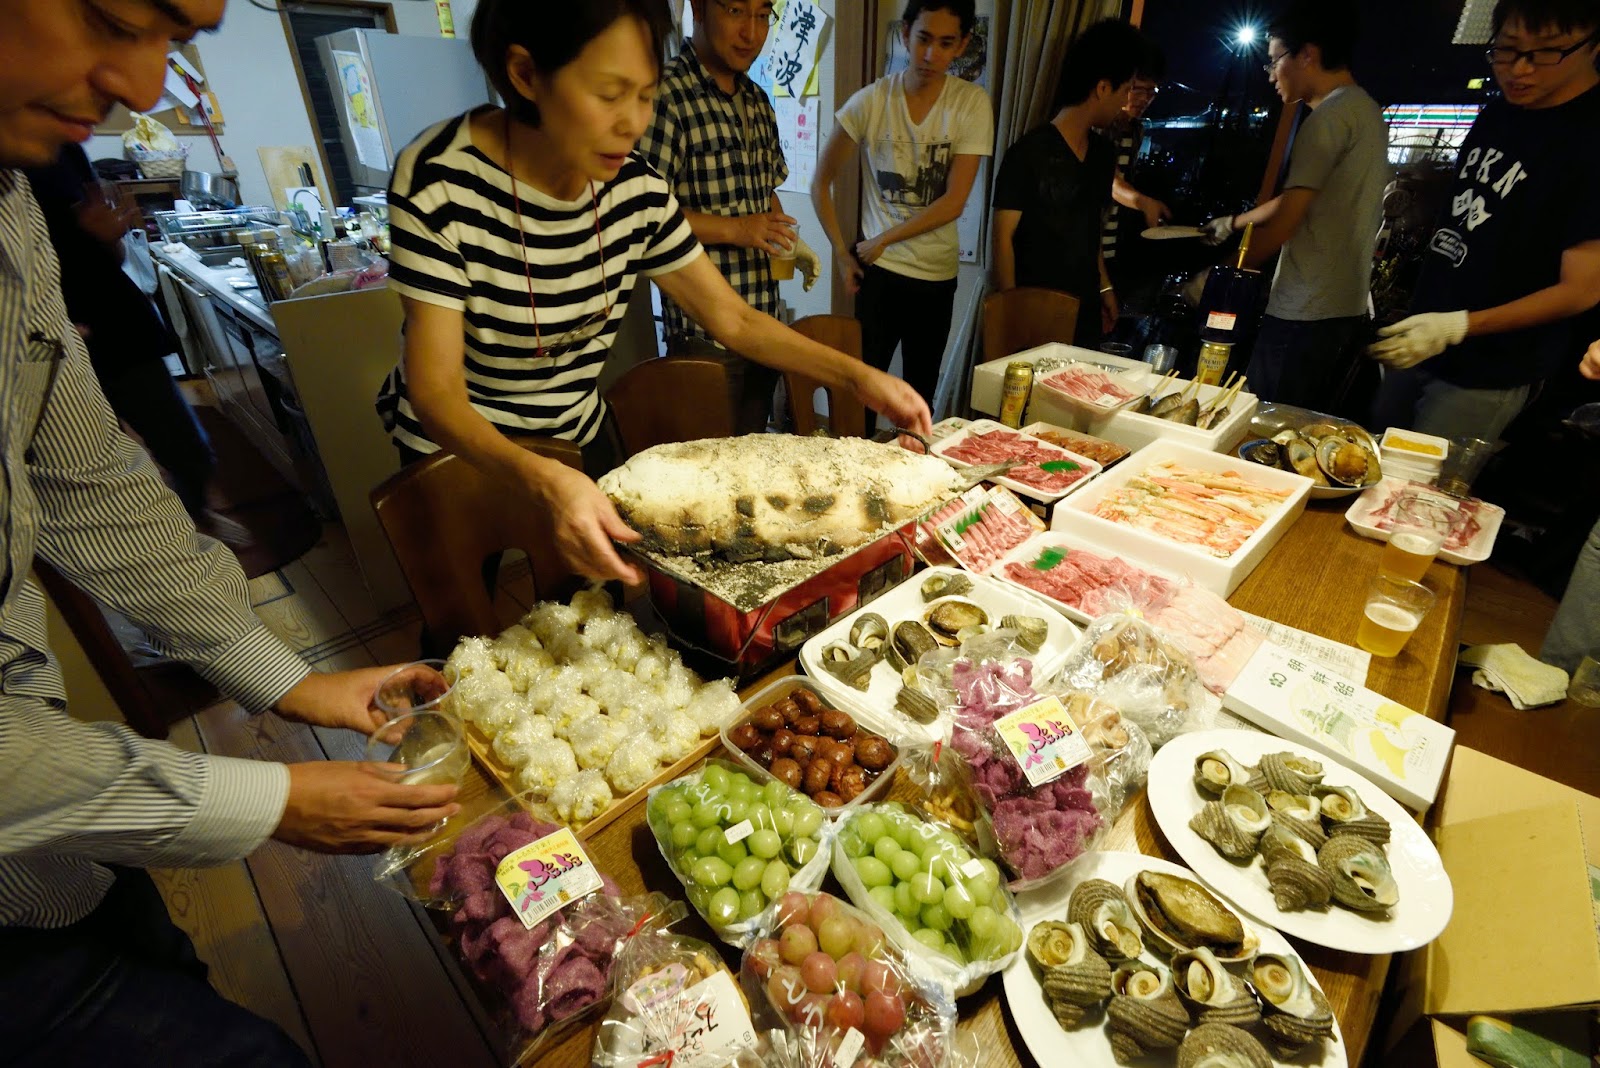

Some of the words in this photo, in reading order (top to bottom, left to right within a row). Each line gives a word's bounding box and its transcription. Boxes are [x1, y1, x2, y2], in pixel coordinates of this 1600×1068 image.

[1459, 147, 1528, 200] PKN
[1287, 658, 1355, 697] 朝鮮飴
